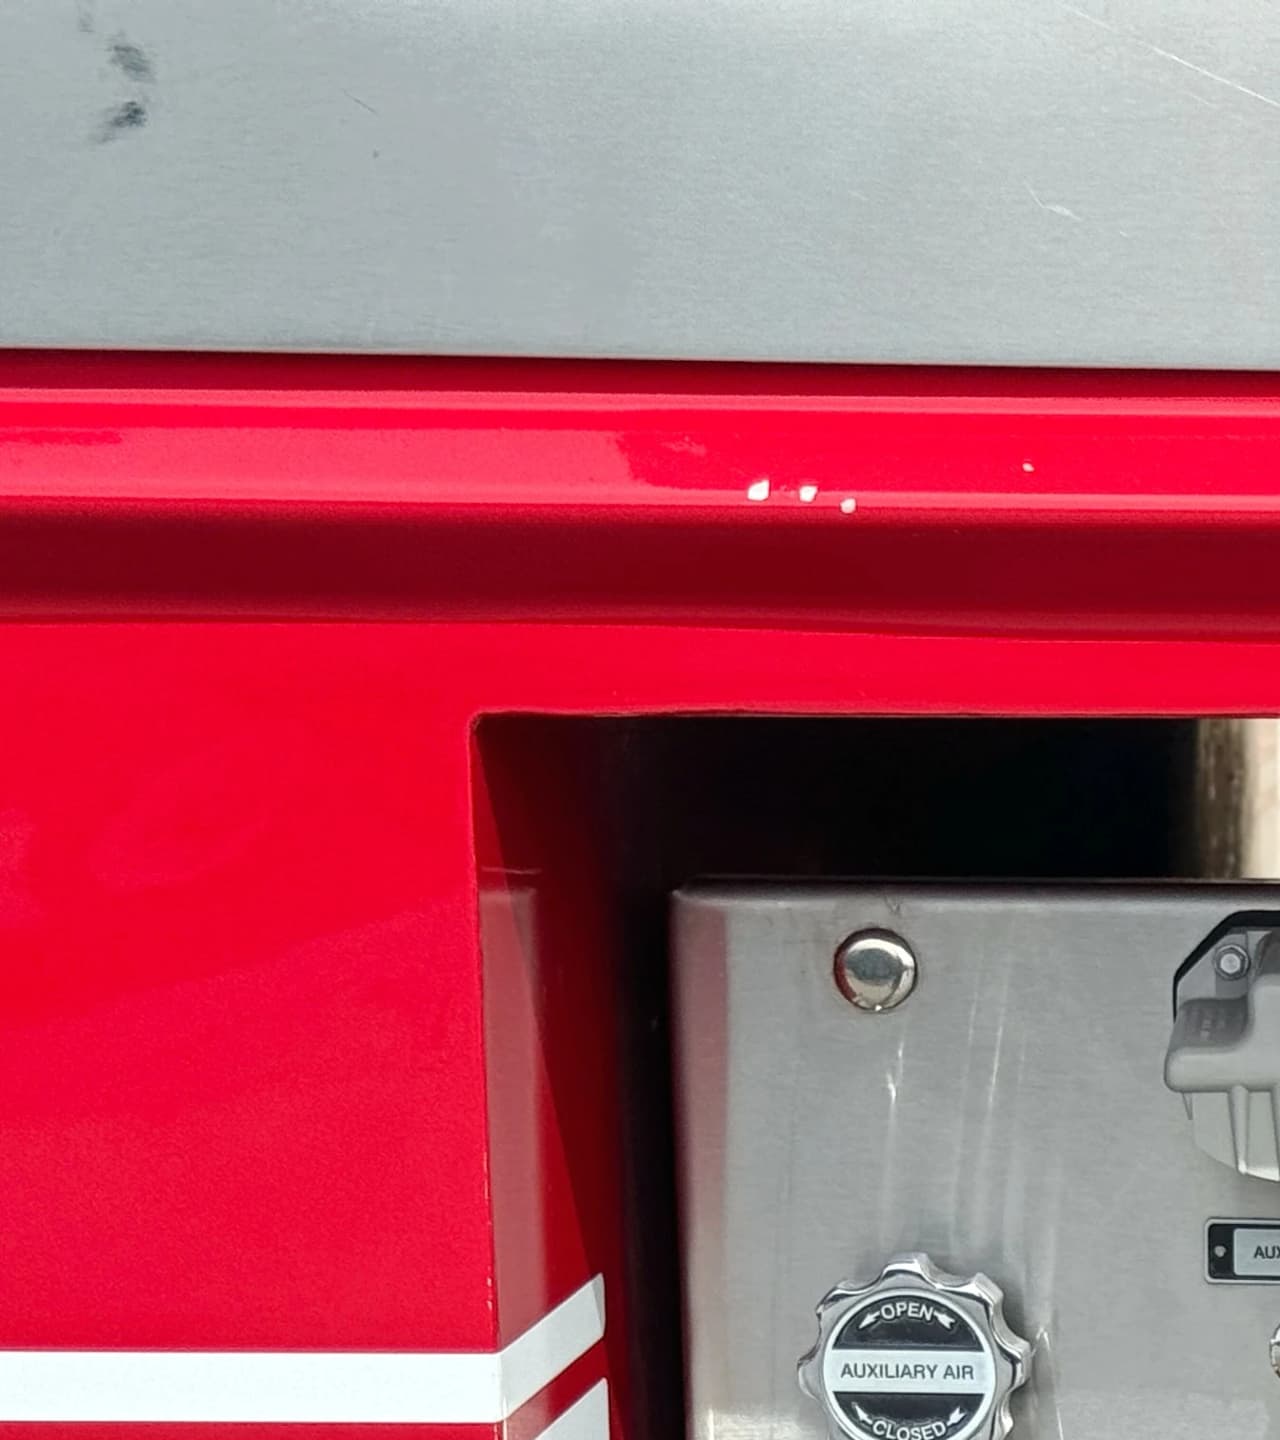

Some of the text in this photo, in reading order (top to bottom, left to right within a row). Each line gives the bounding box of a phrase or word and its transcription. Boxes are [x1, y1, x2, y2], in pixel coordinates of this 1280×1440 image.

[881, 1301, 934, 1321] OPEN
[840, 1363, 975, 1380] AUXILIARY AIR
